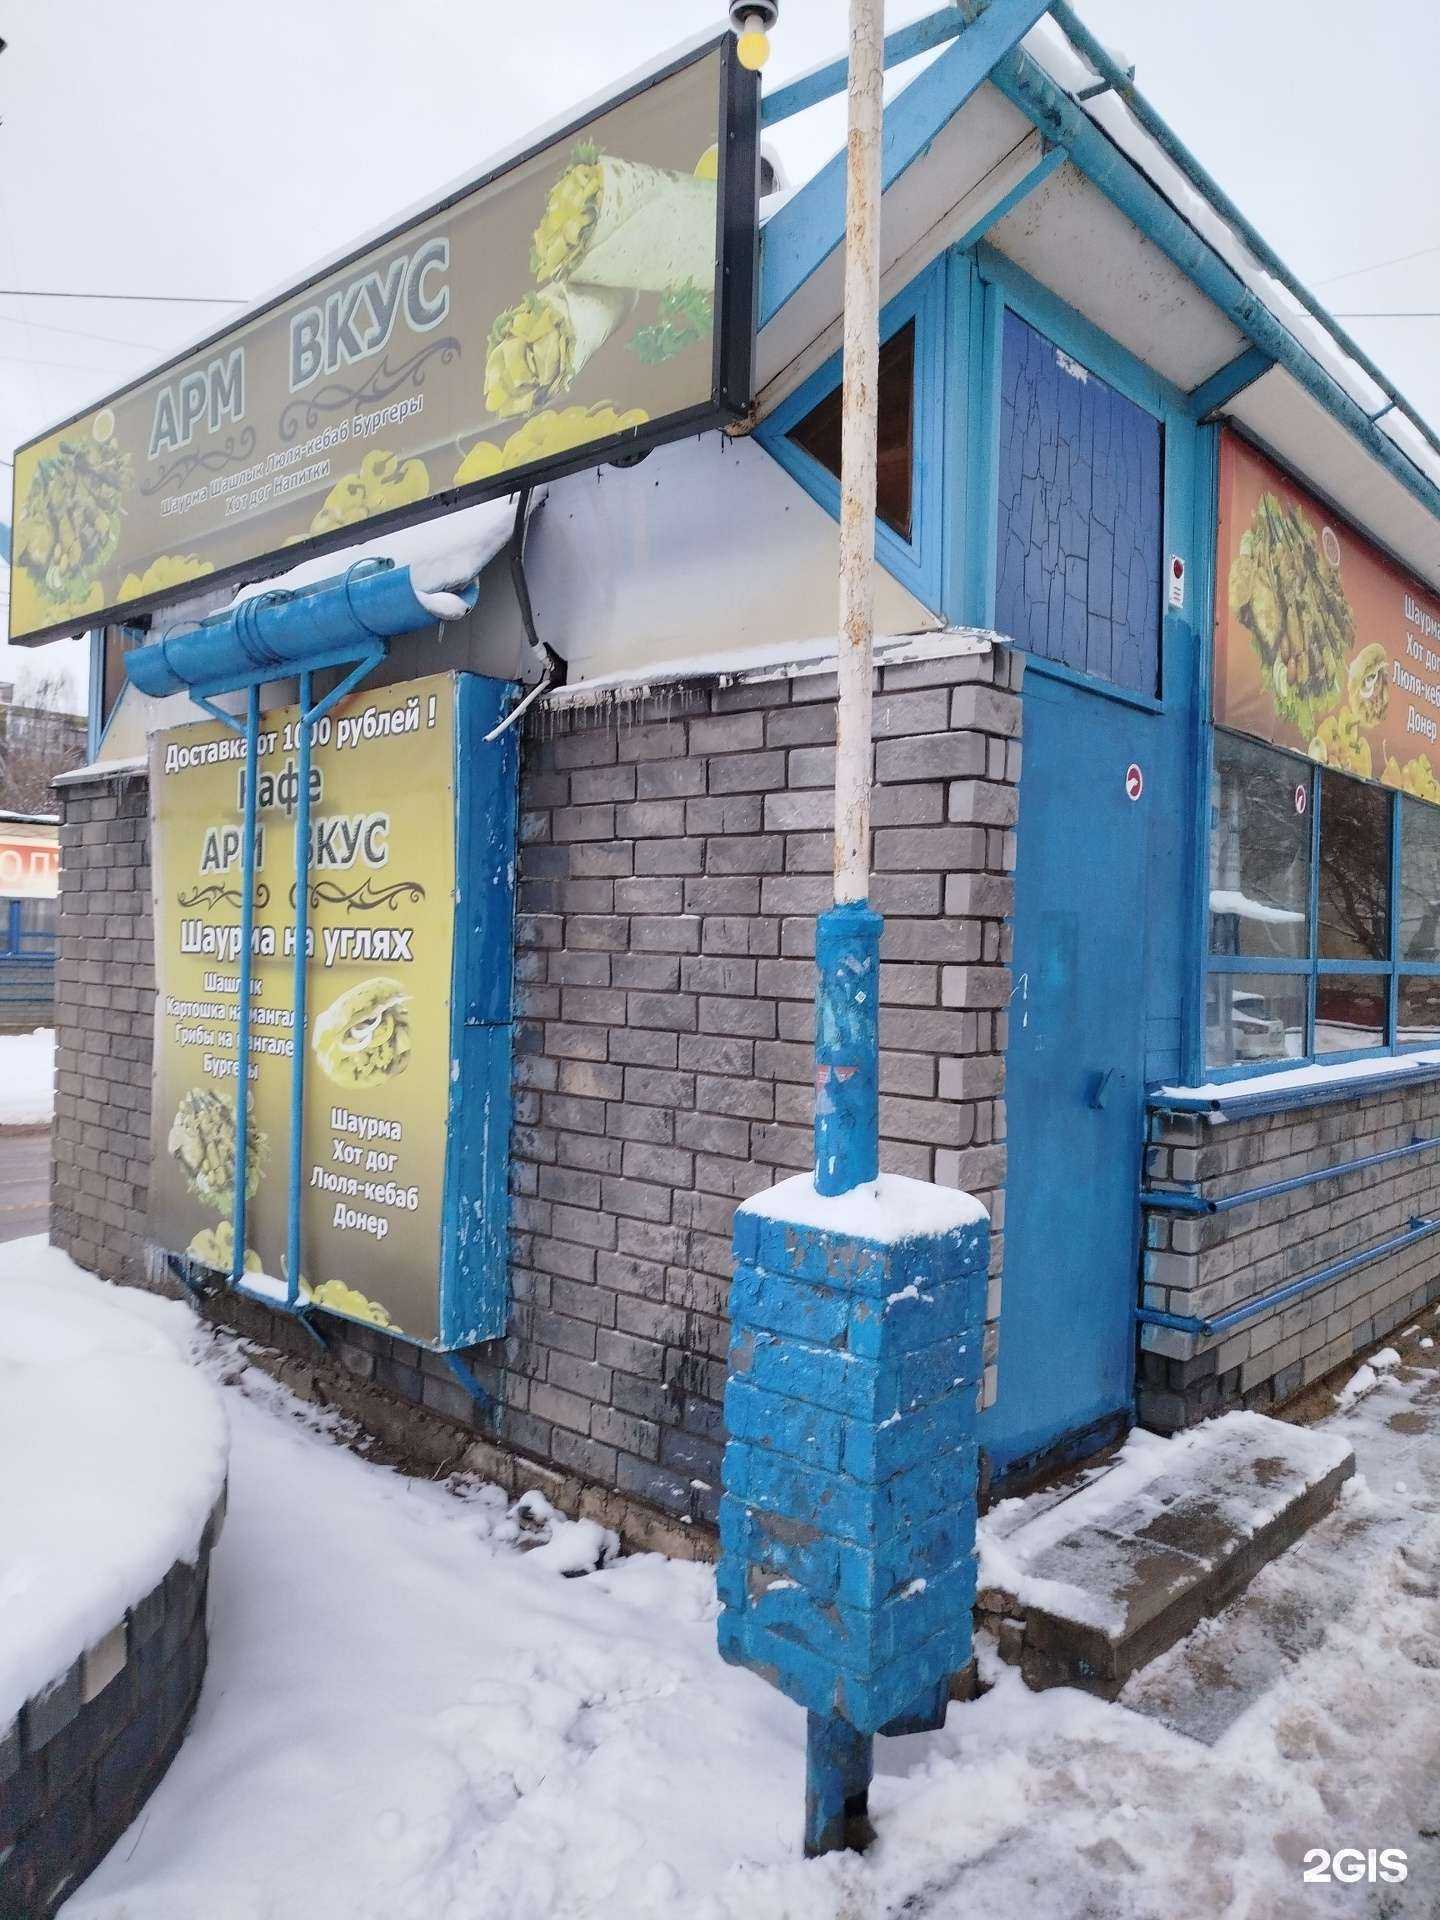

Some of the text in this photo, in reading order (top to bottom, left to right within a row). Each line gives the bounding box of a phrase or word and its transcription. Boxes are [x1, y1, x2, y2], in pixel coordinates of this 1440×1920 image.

[147, 237, 450, 460] АРМ ВКУС
[160, 394, 424, 517] Шаурма Шашлык Люля-кебаб Бургеры
[225, 458, 331, 516] Хот дог Напитки
[1406, 631, 1424, 662] Хот
[164, 736, 248, 773] Доставка
[256, 731, 277, 756] от
[336, 699, 420, 750] рублей
[1407, 704, 1437, 744] Донер
[323, 927, 414, 967] углях
[166, 994, 226, 1022] Картошка
[175, 1021, 215, 1048] Грибы
[217, 1030, 233, 1048] на
[203, 1052, 260, 1080] Бургеы
[330, 1106, 402, 1142] Шаурма
[332, 1139, 399, 1173] Хот дог
[310, 1166, 420, 1211] Люля-кебаб
[332, 1202, 390, 1240] Донер
